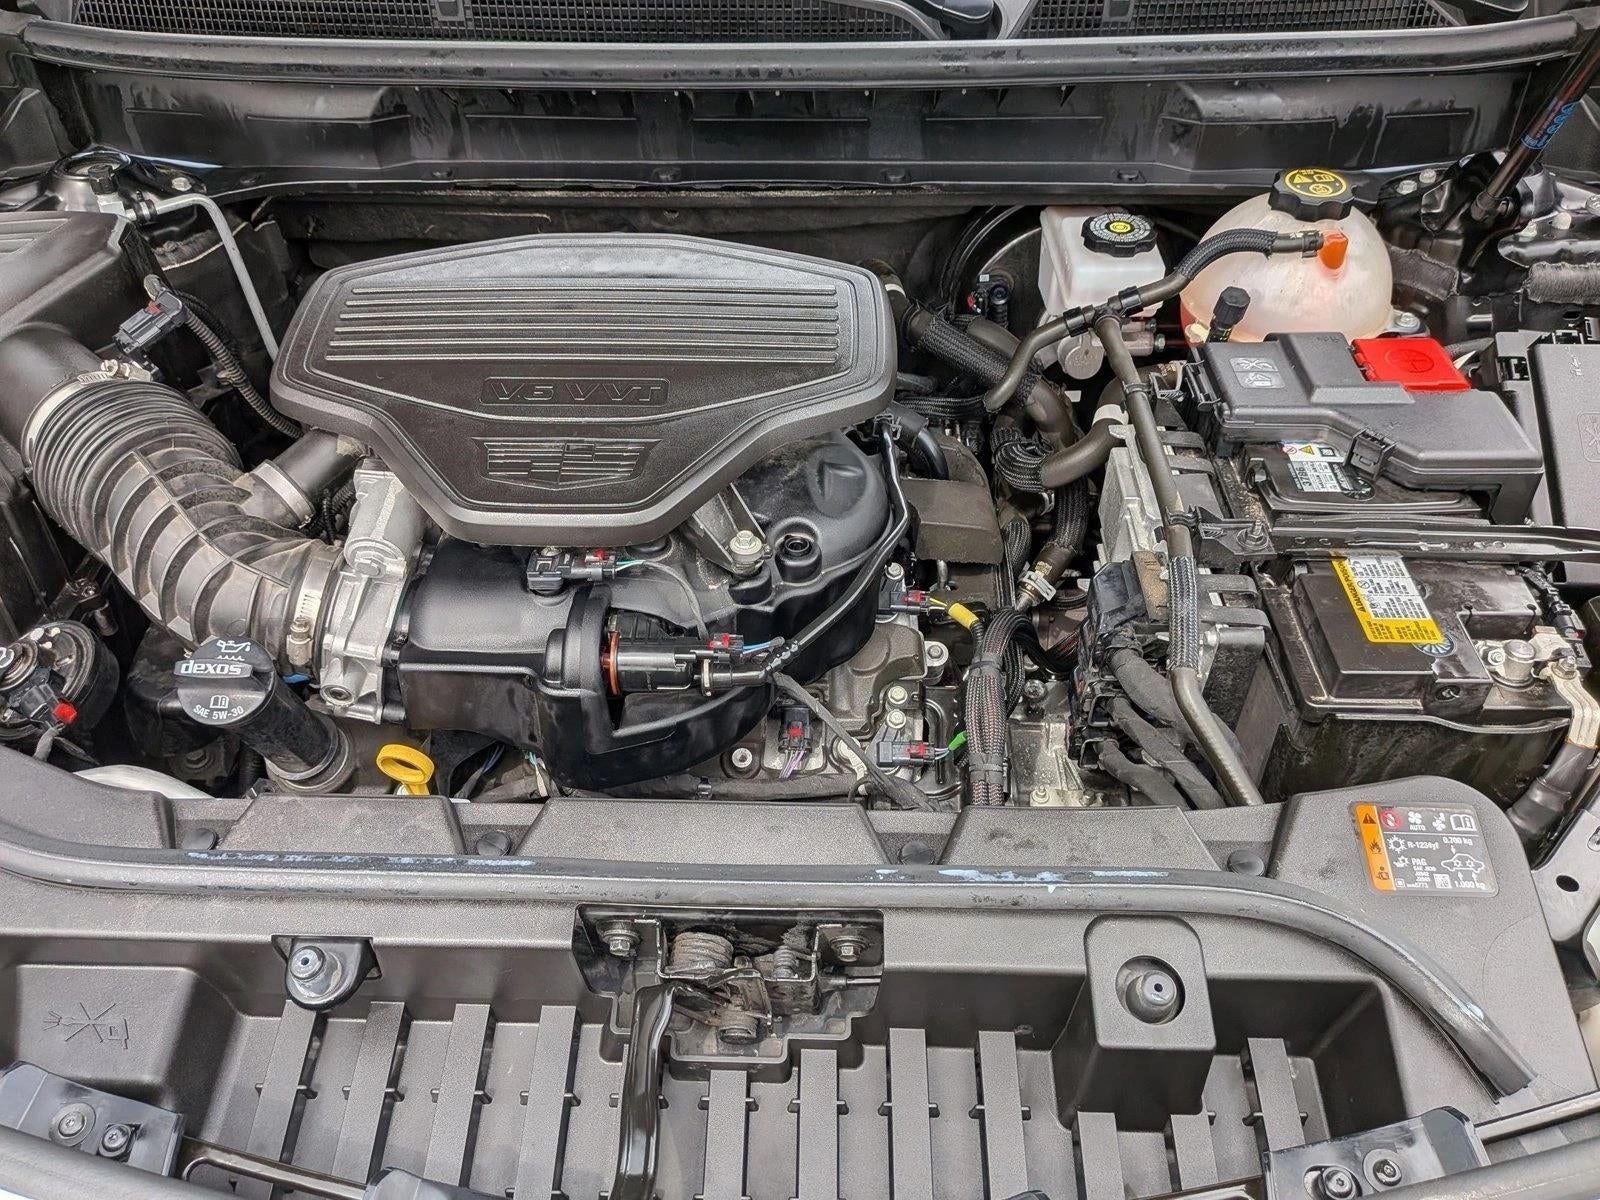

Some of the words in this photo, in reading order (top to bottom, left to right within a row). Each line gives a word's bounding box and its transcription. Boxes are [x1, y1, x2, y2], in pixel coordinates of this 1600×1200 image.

[490, 382, 554, 400] V6
[565, 383, 661, 402] VVT
[181, 660, 243, 675] dexos
[193, 704, 210, 718] SAE
[212, 705, 244, 720] 5W-30
[1463, 838, 1473, 846] kg
[1411, 858, 1427, 866] PAG
